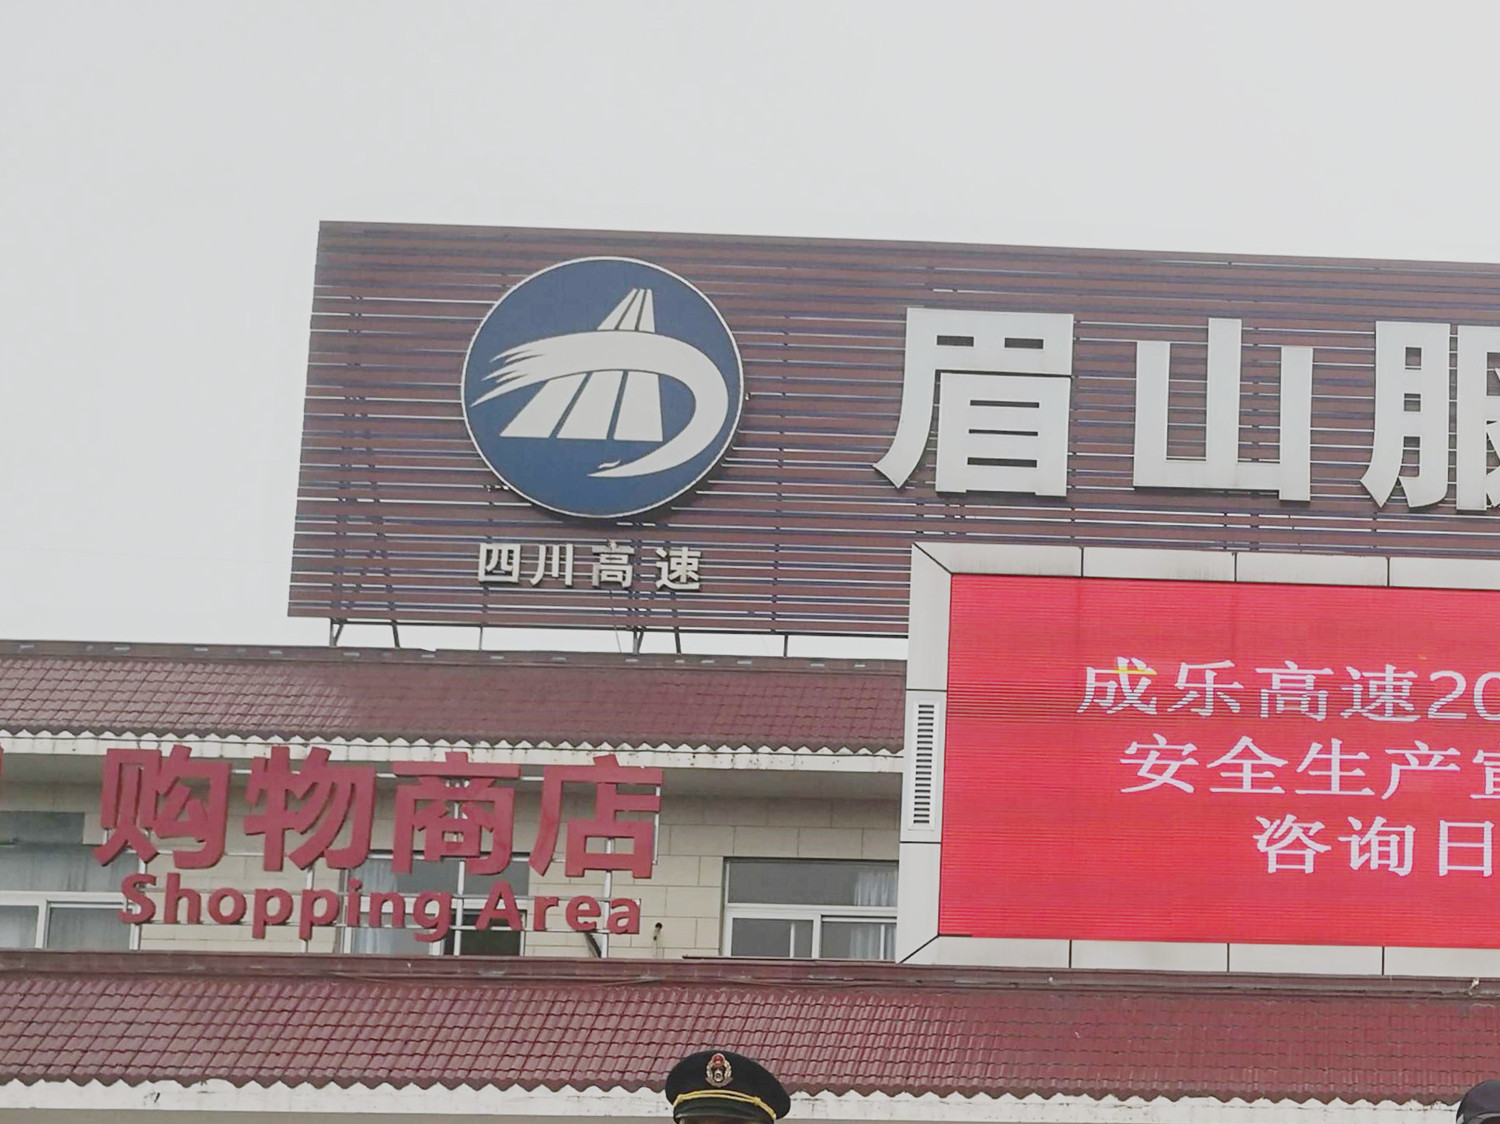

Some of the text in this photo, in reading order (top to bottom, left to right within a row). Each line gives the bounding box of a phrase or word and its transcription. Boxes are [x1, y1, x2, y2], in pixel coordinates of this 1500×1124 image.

[477, 541, 703, 592] 四川高速
[94, 745, 664, 879] 购物商店
[1253, 814, 1497, 878] 咨询日
[118, 872, 642, 943] Shopping Area
